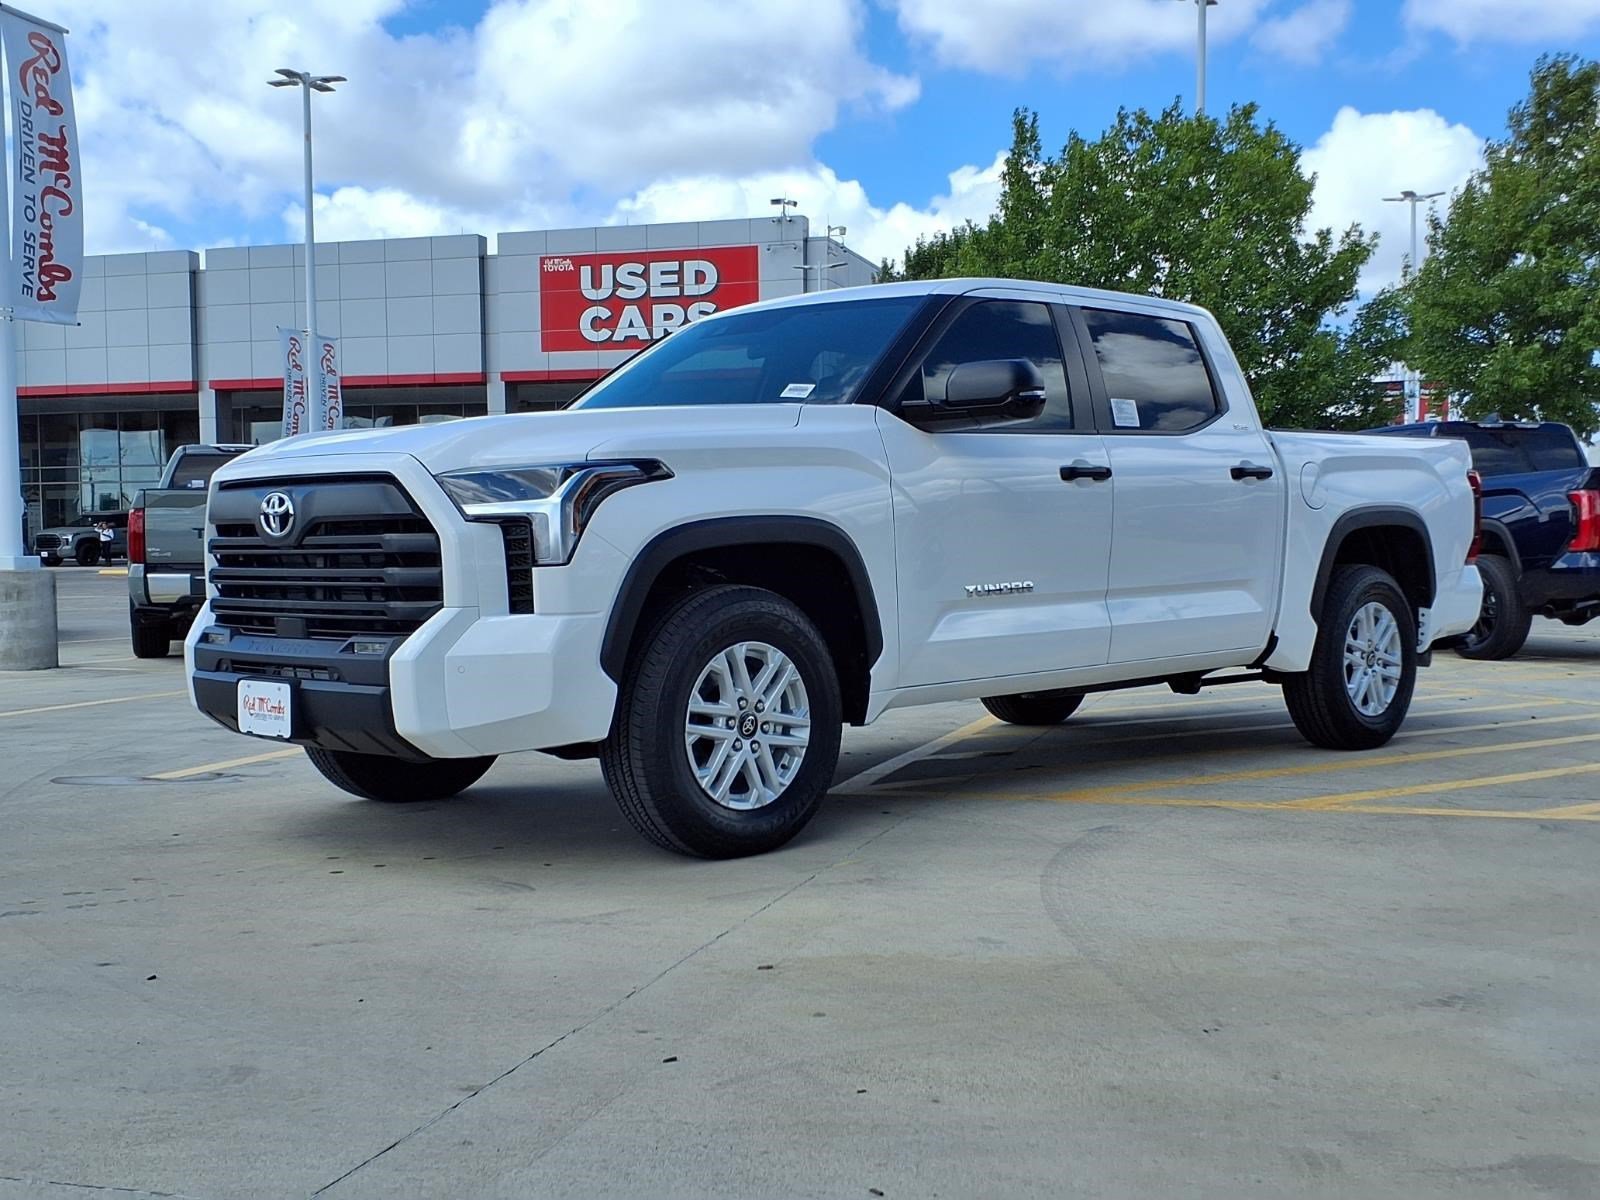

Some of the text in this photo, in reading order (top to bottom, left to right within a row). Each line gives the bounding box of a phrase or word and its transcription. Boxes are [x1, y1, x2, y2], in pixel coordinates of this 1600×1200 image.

[20, 31, 73, 301] Red McCombs
[21, 100, 36, 298] DRIVEN TO SERVE
[543, 263, 574, 272] TOYOTA
[580, 259, 718, 301] USED
[320, 343, 337, 377] Red
[287, 336, 305, 437] Red McCom
[964, 581, 1034, 598] TUNDRA
